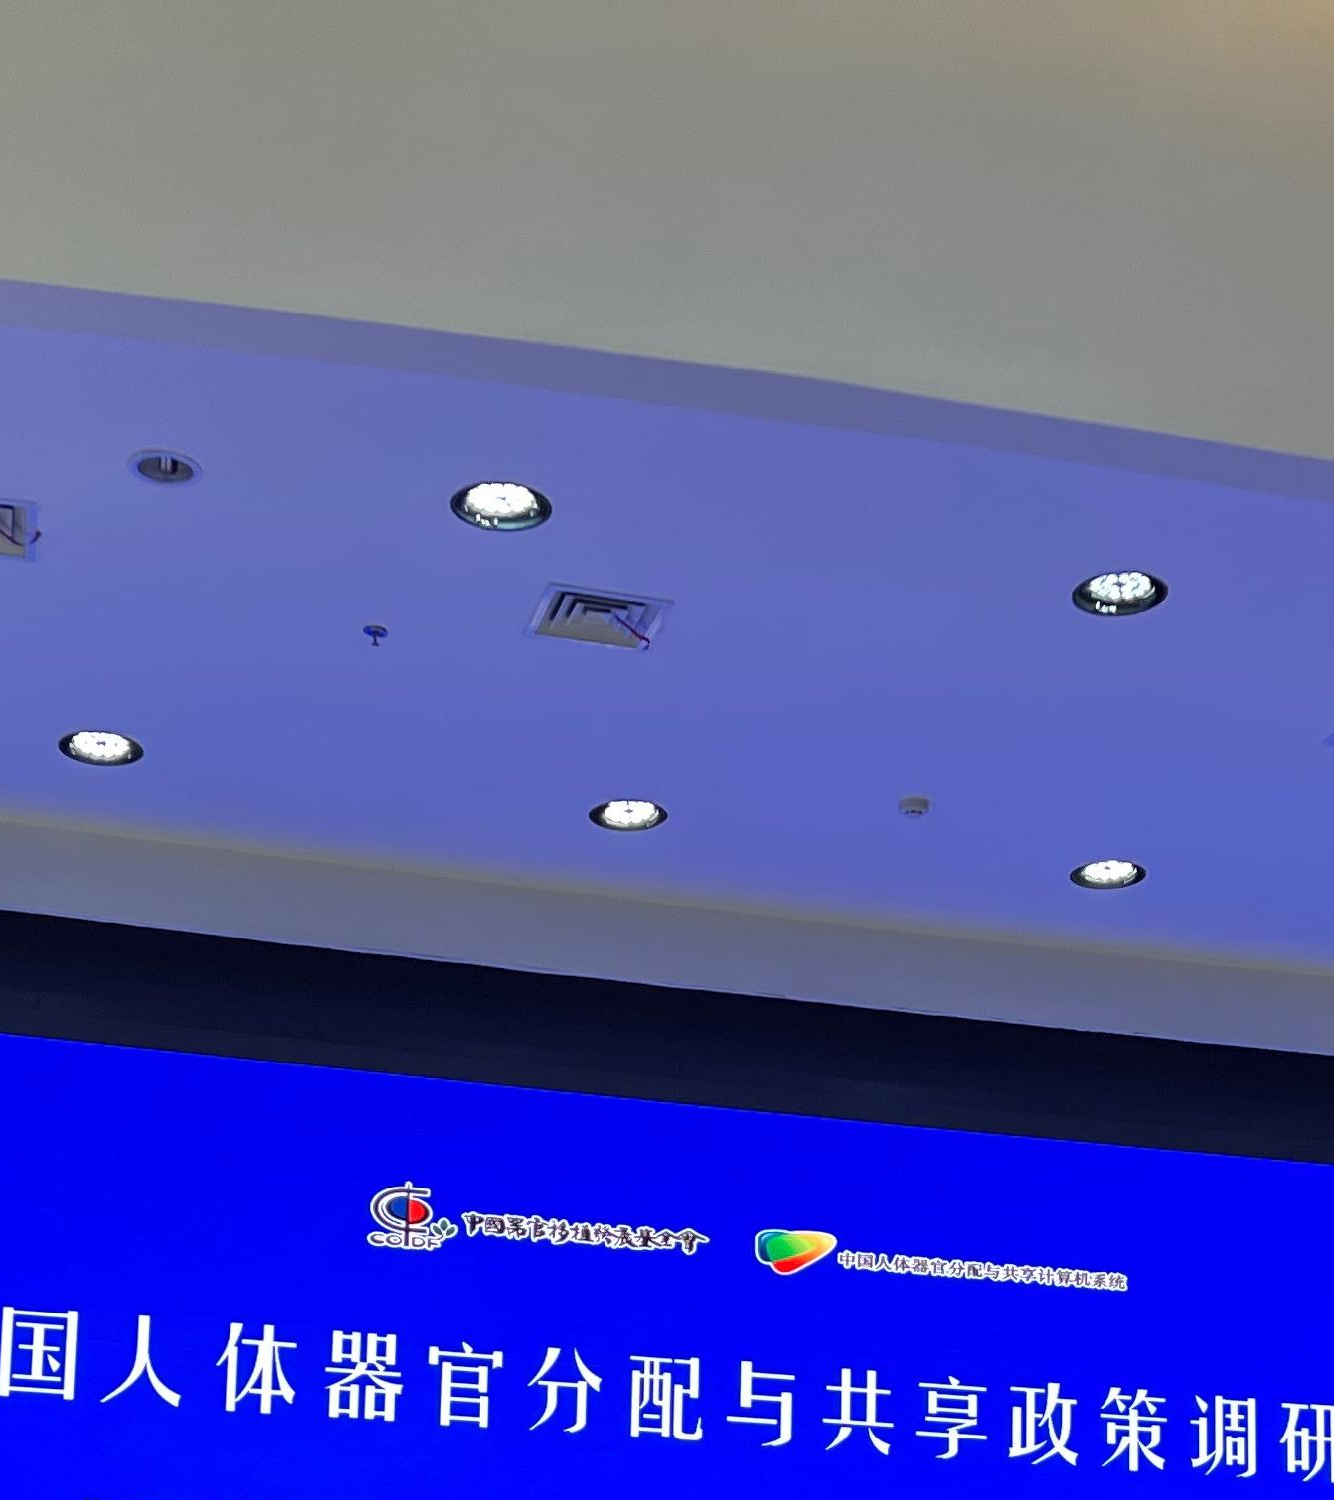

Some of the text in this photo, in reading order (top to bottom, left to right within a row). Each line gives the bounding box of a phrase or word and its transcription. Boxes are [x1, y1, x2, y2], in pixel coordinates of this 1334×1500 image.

[837, 1250, 1128, 1291] 中国人体器官分配与共享计算机系统
